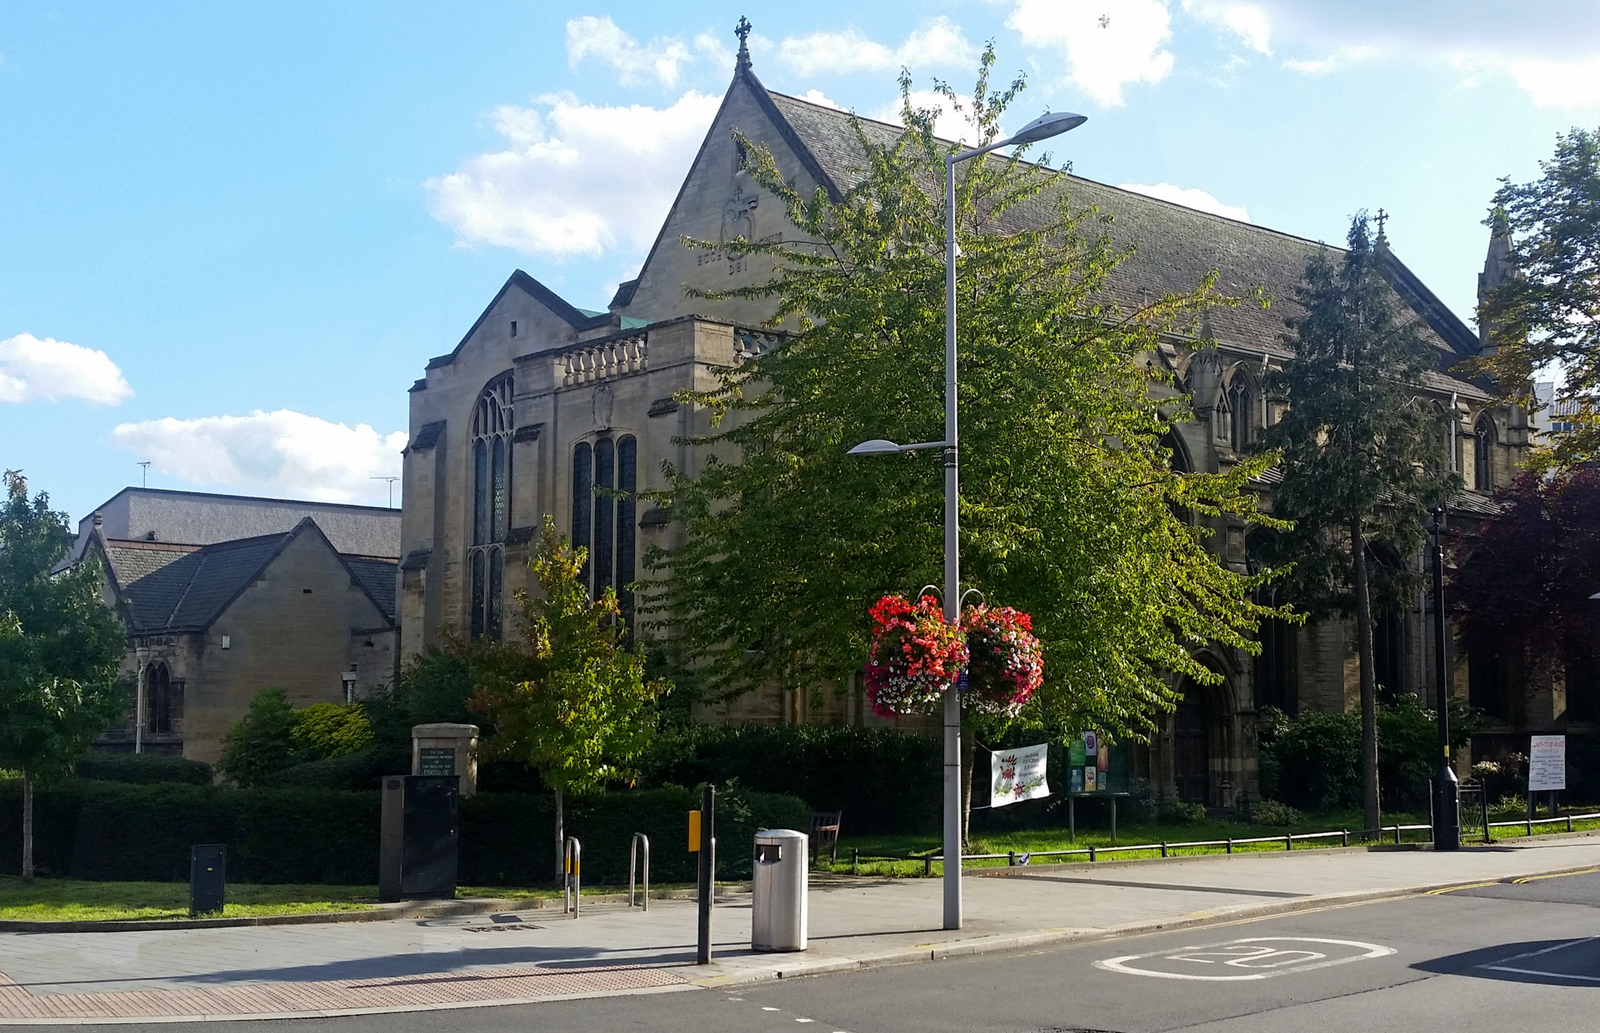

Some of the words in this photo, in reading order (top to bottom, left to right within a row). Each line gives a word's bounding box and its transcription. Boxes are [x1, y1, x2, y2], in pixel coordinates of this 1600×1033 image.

[697, 251, 721, 266] ECCE
[728, 261, 748, 275] DEI
[1165, 945, 1326, 968] 20
